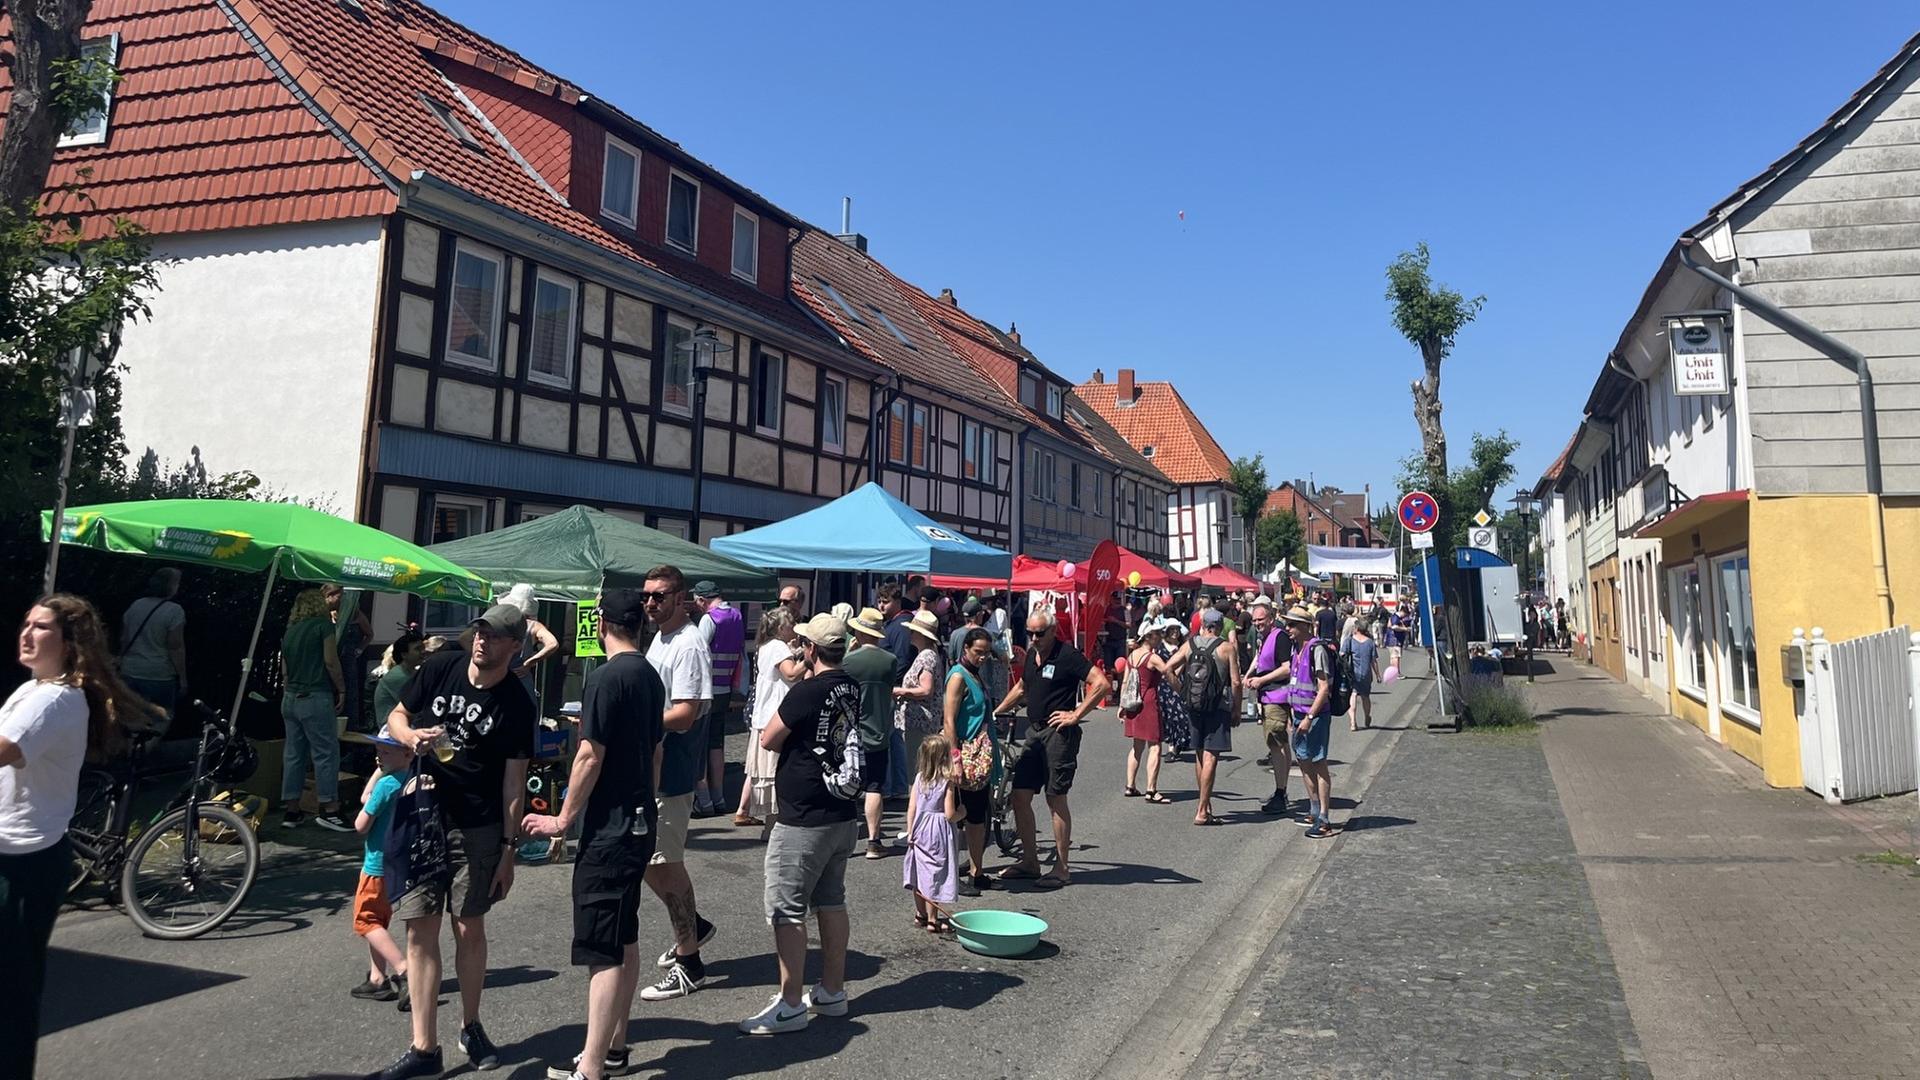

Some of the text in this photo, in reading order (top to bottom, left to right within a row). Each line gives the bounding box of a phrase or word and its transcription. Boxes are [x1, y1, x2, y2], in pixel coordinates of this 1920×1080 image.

[204, 536, 219, 546] 90
[1478, 534, 1488, 542] 30
[344, 556, 395, 572] BÜNDNIS 90
[342, 565, 357, 575] DIE
[1096, 569, 1111, 580] SPD
[579, 624, 598, 637] AF
[816, 711, 831, 742] FEINE
